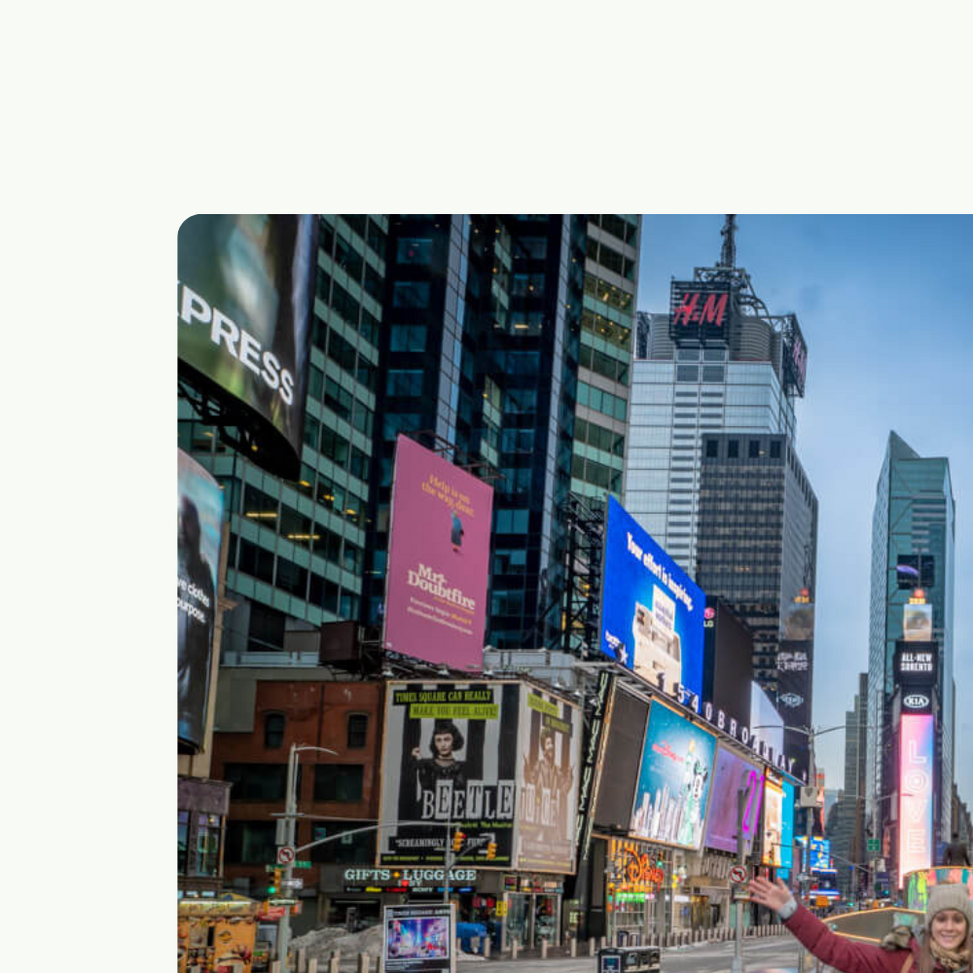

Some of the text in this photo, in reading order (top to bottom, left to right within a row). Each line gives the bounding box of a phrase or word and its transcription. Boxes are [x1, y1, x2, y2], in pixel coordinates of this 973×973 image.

[673, 292, 729, 327] H&M
[178, 281, 294, 405] PRESS
[407, 569, 476, 611] Doubtfire
[418, 691, 447, 704] SQUARE
[421, 780, 514, 820] BEETLE
[344, 868, 477, 881] GIFTS LUGGAGE
